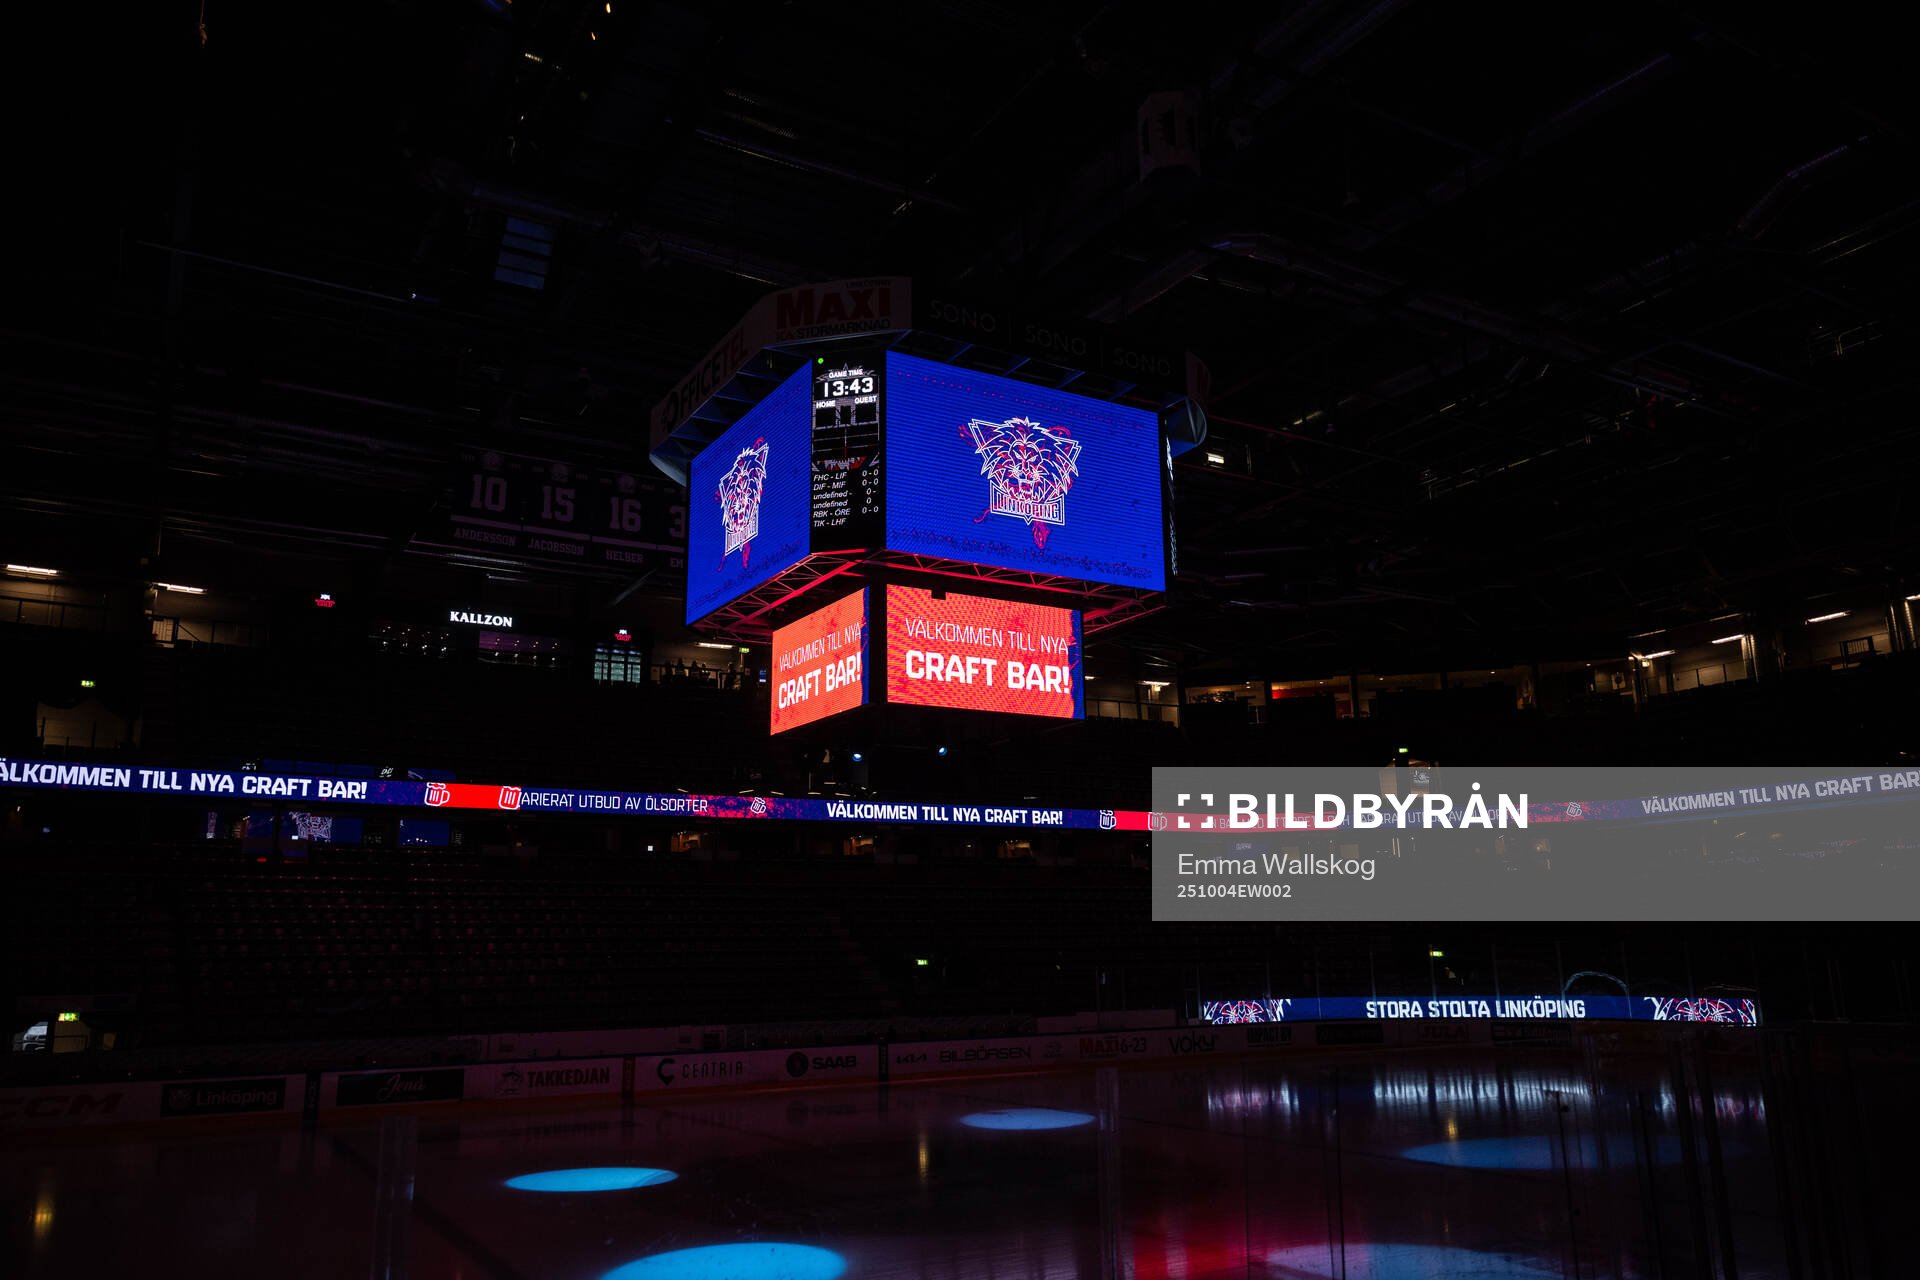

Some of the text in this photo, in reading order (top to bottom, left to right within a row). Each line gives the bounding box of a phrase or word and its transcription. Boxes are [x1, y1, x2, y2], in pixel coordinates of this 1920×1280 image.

[777, 288, 891, 330] MAXI
[929, 297, 999, 332] SONO
[797, 319, 891, 339] STORMARKNAD
[1024, 321, 1087, 356] SONO
[1112, 346, 1174, 376] SONO
[664, 327, 747, 433] OFFICETEL
[824, 377, 873, 397] 13:43
[816, 400, 836, 409] HOME
[855, 396, 877, 404] GUEST
[470, 473, 508, 513] 10
[813, 490, 848, 499] undefined
[832, 481, 846, 489] MIF
[541, 485, 576, 522] 15
[813, 499, 848, 509] undefined
[813, 510, 828, 518] RBK
[608, 496, 642, 533] 16
[453, 527, 517, 547] ANDERSSON
[528, 538, 584, 556] JACOBSSON
[450, 610, 513, 627] KALLZON
[906, 616, 1068, 655] VÄLKOMMEN TILL NYA
[779, 622, 862, 672] VÄLKOMMEN TILL NYA
[778, 651, 862, 709] CRAFT BAR!
[906, 650, 1070, 693] CRAFT BAR!
[139, 769, 182, 790] TILL
[190, 773, 234, 793] NYA
[242, 775, 311, 797] CRAFT
[318, 779, 367, 799] BAR!
[578, 794, 621, 809] UTBUD
[625, 797, 641, 811] AV
[645, 795, 708, 813] ÖLSORTER
[1641, 790, 1735, 814] VÄLKOMMEN
[1739, 787, 1771, 804] TILL
[1776, 783, 1810, 801] NYA
[1815, 776, 1873, 797] CRAFT
[826, 799, 1063, 825] VÄLKOMMEN TILL NYA CRAFT BAR!
[1366, 995, 1586, 1018] STORA STOLTA LINKÖPING
[940, 1045, 1031, 1063] BILBÖRSEN
[1079, 1036, 1118, 1055] MAXI
[1120, 1037, 1146, 1053] 6-23
[682, 1060, 743, 1079] CENTRIA
[812, 1055, 857, 1070] SAAB
[527, 1067, 610, 1087] TAKKEDJAN
[196, 1086, 278, 1108] Linköping
